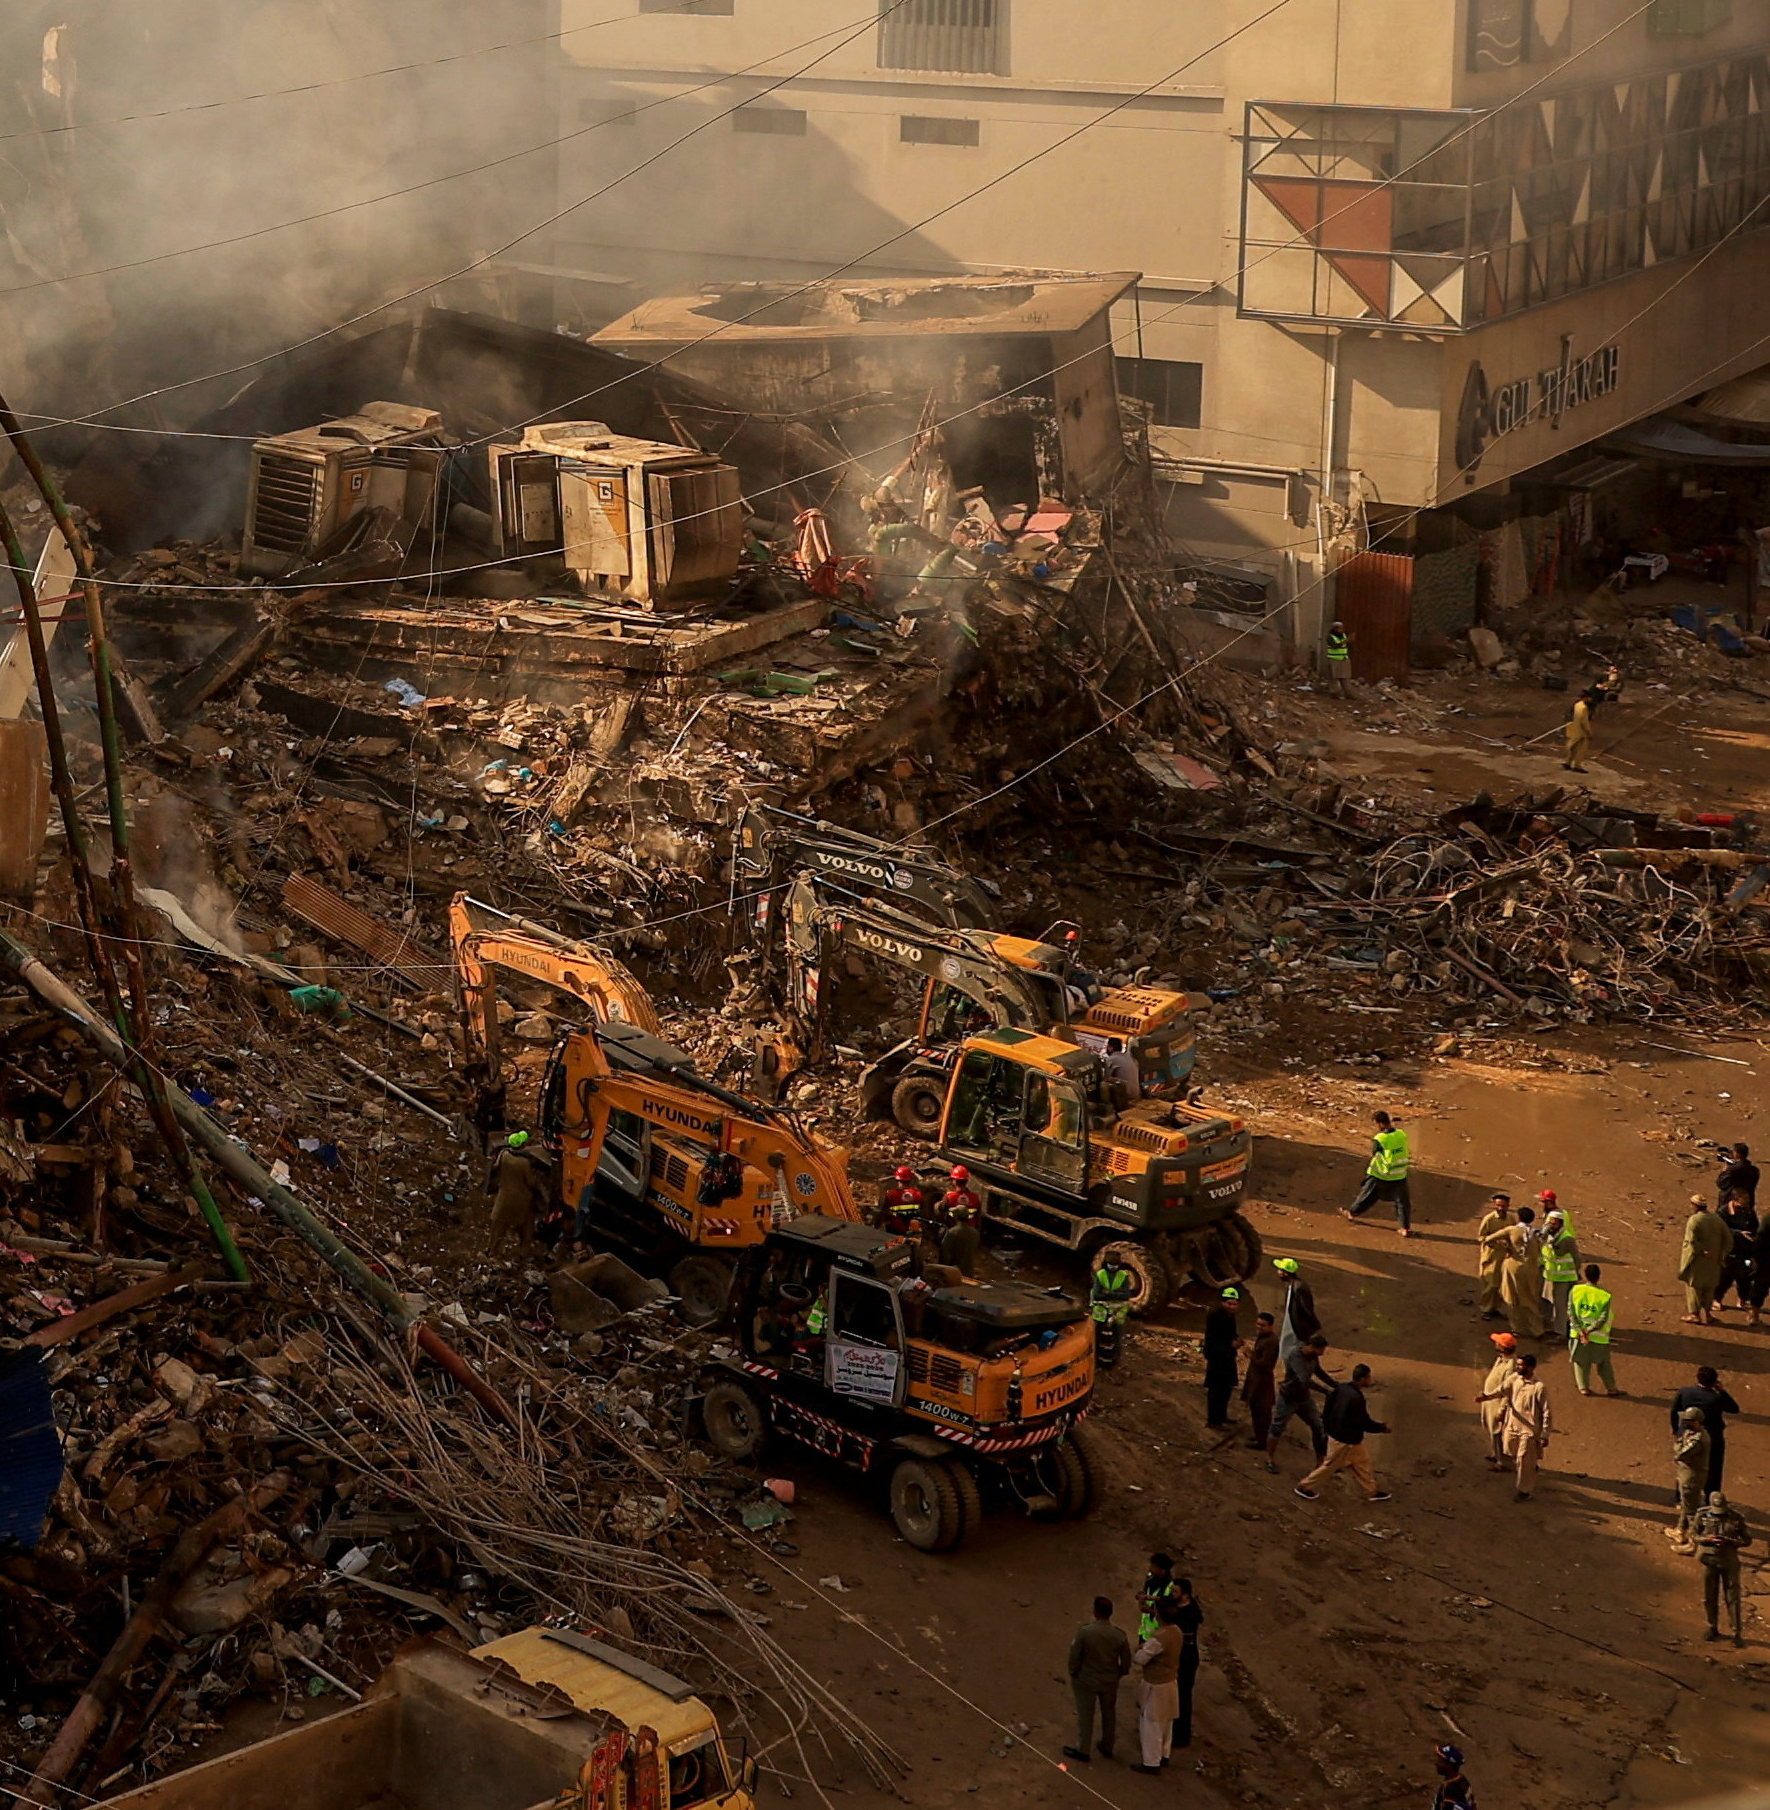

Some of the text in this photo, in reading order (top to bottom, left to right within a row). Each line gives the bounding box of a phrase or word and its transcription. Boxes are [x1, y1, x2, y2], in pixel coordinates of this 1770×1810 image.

[1492, 377, 1535, 437] GUL
[816, 852, 886, 880] VOLVO
[501, 947, 552, 975] HYUNDAI
[856, 927, 924, 963] VOLVO
[642, 1099, 714, 1134] HYUNDA
[1208, 1180, 1243, 1200] VOLVO
[1035, 1372, 1090, 1410] HYUNDAI
